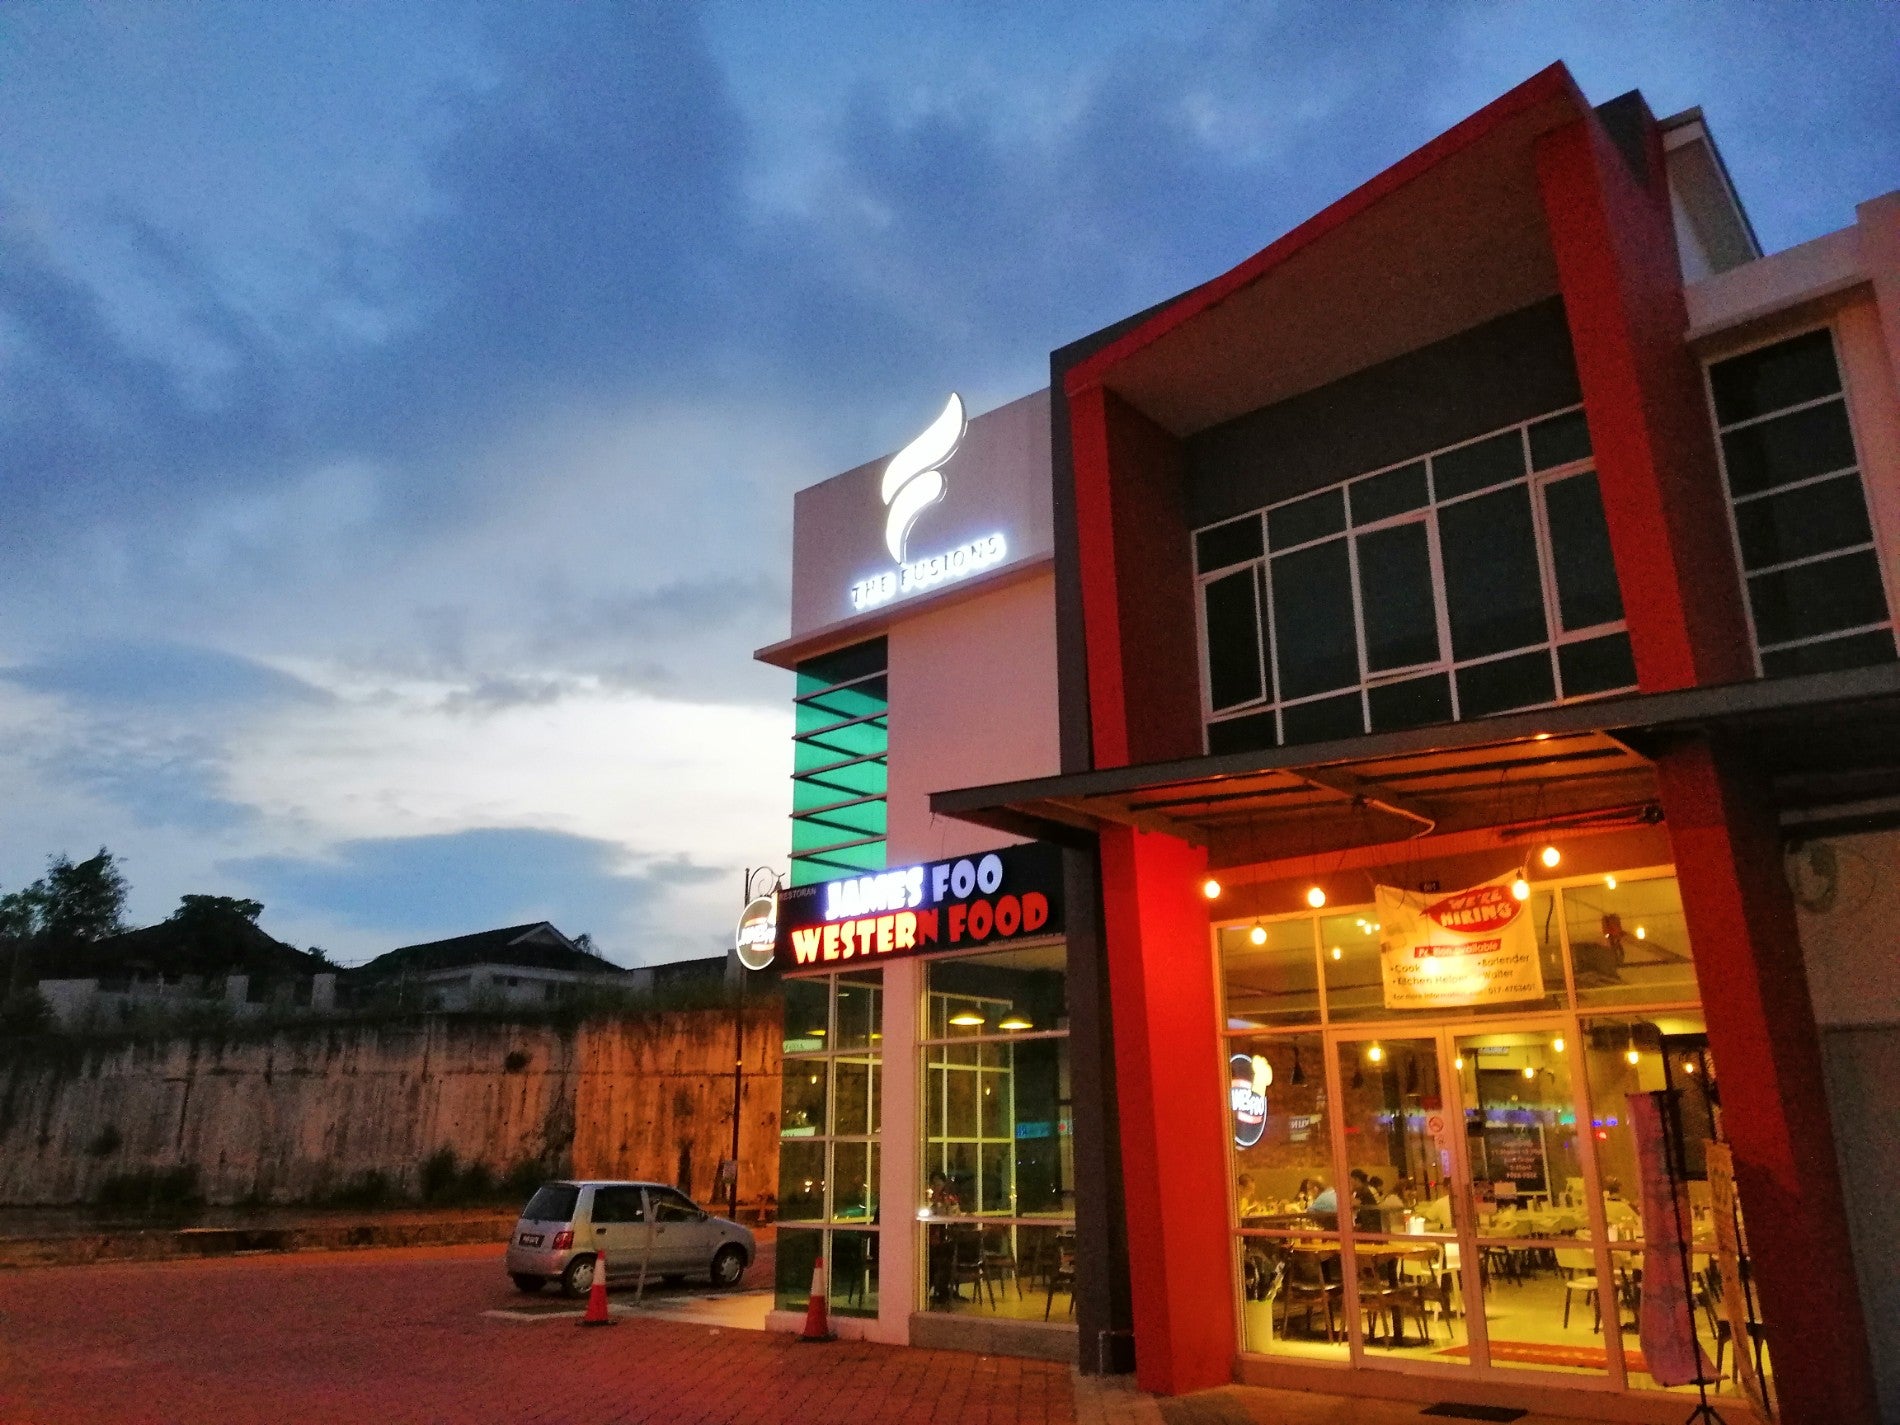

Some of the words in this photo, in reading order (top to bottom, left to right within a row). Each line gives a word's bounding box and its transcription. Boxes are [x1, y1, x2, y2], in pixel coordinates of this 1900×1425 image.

[852, 571, 896, 609] THE
[901, 533, 1006, 592] FUSIONS
[932, 854, 1003, 902] FOO
[1440, 902, 1513, 927] HIRING
[791, 911, 939, 964] WESTERN
[949, 892, 1048, 943] FOOD
[1394, 964, 1420, 973] Cook
[1482, 954, 1530, 967] Bartender
[1483, 969, 1513, 980] Waiter
